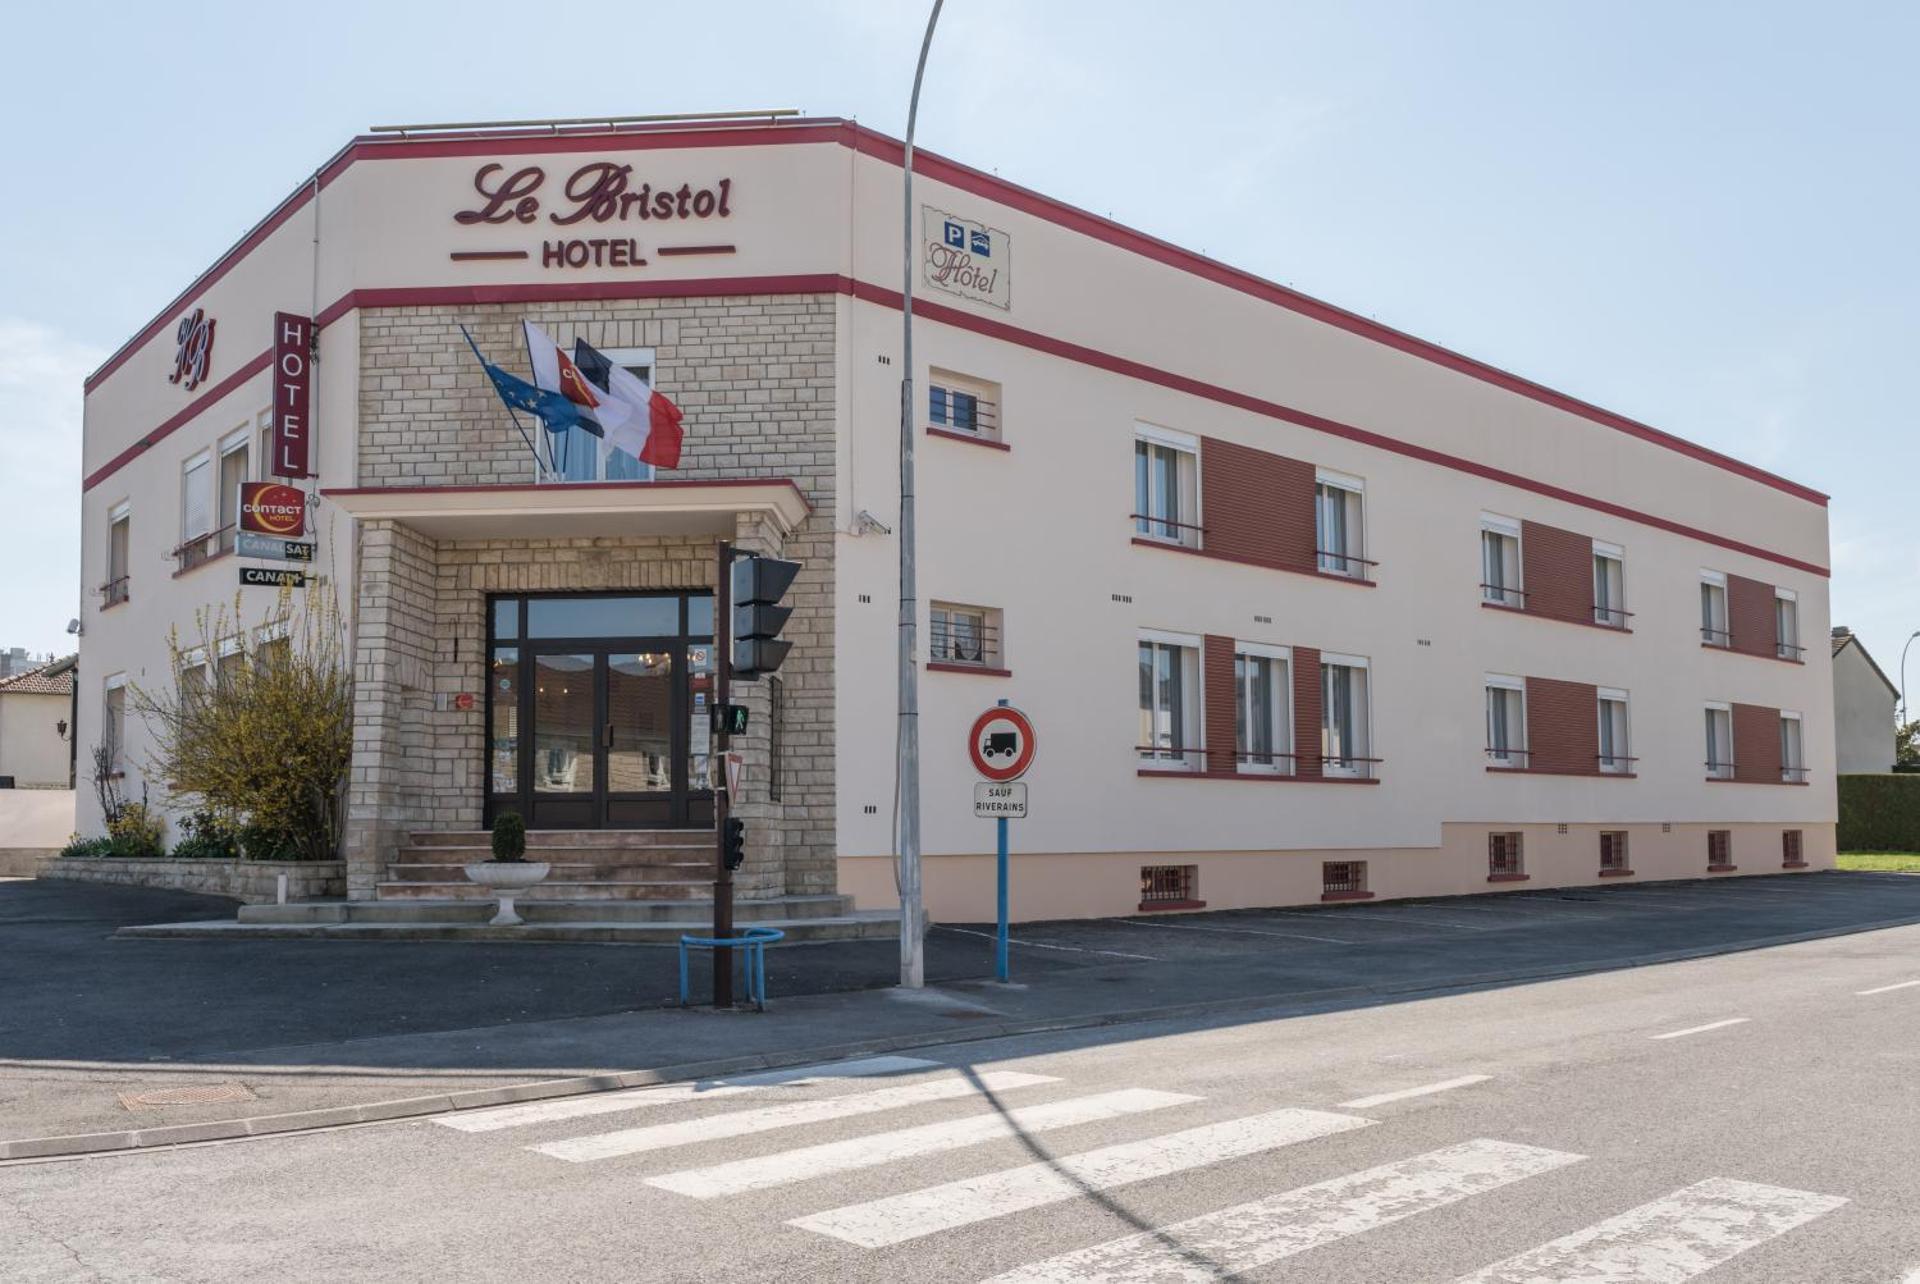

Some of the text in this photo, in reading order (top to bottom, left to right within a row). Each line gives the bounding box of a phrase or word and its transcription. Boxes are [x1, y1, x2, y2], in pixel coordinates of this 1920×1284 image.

[453, 162, 731, 226] Le Bristol
[542, 239, 648, 269] HOTEL
[282, 322, 303, 469] HOTEL
[976, 802, 1024, 811] RIVERAINS
[989, 788, 1012, 797] SAUF
